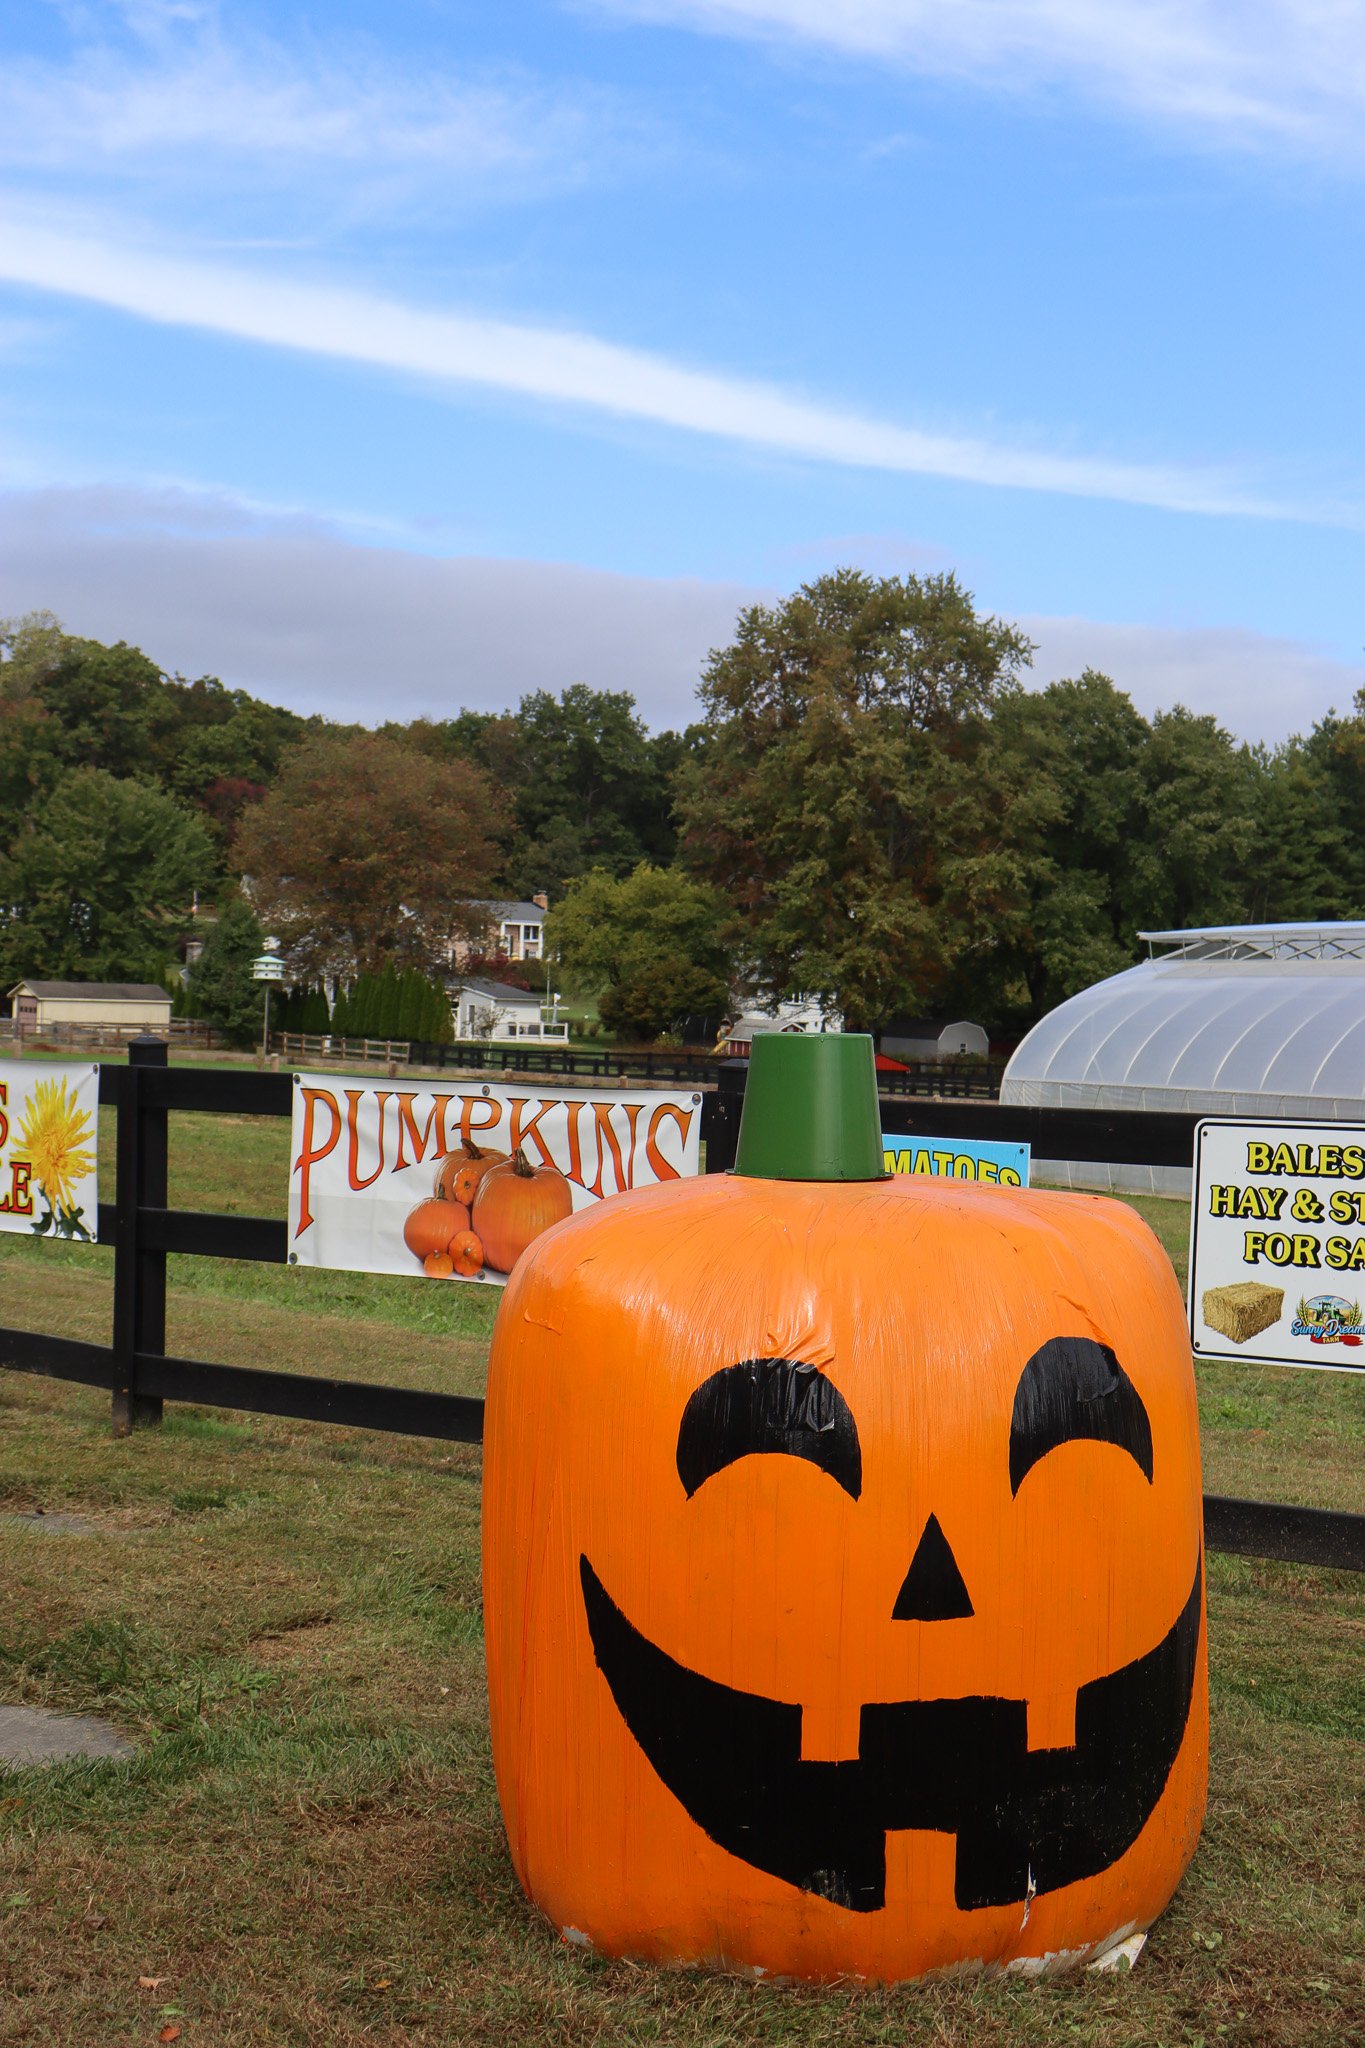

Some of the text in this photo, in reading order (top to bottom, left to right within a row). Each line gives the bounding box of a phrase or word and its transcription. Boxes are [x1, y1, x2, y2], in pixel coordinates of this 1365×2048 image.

[1246, 1142, 1365, 1179] BALES
[1210, 1185, 1287, 1220] HAY
[1291, 1188, 1325, 1223] &
[1243, 1231, 1321, 1268] FOR
[1291, 1318, 1326, 1339] Sunny
[1323, 1336, 1340, 1344] FARM
